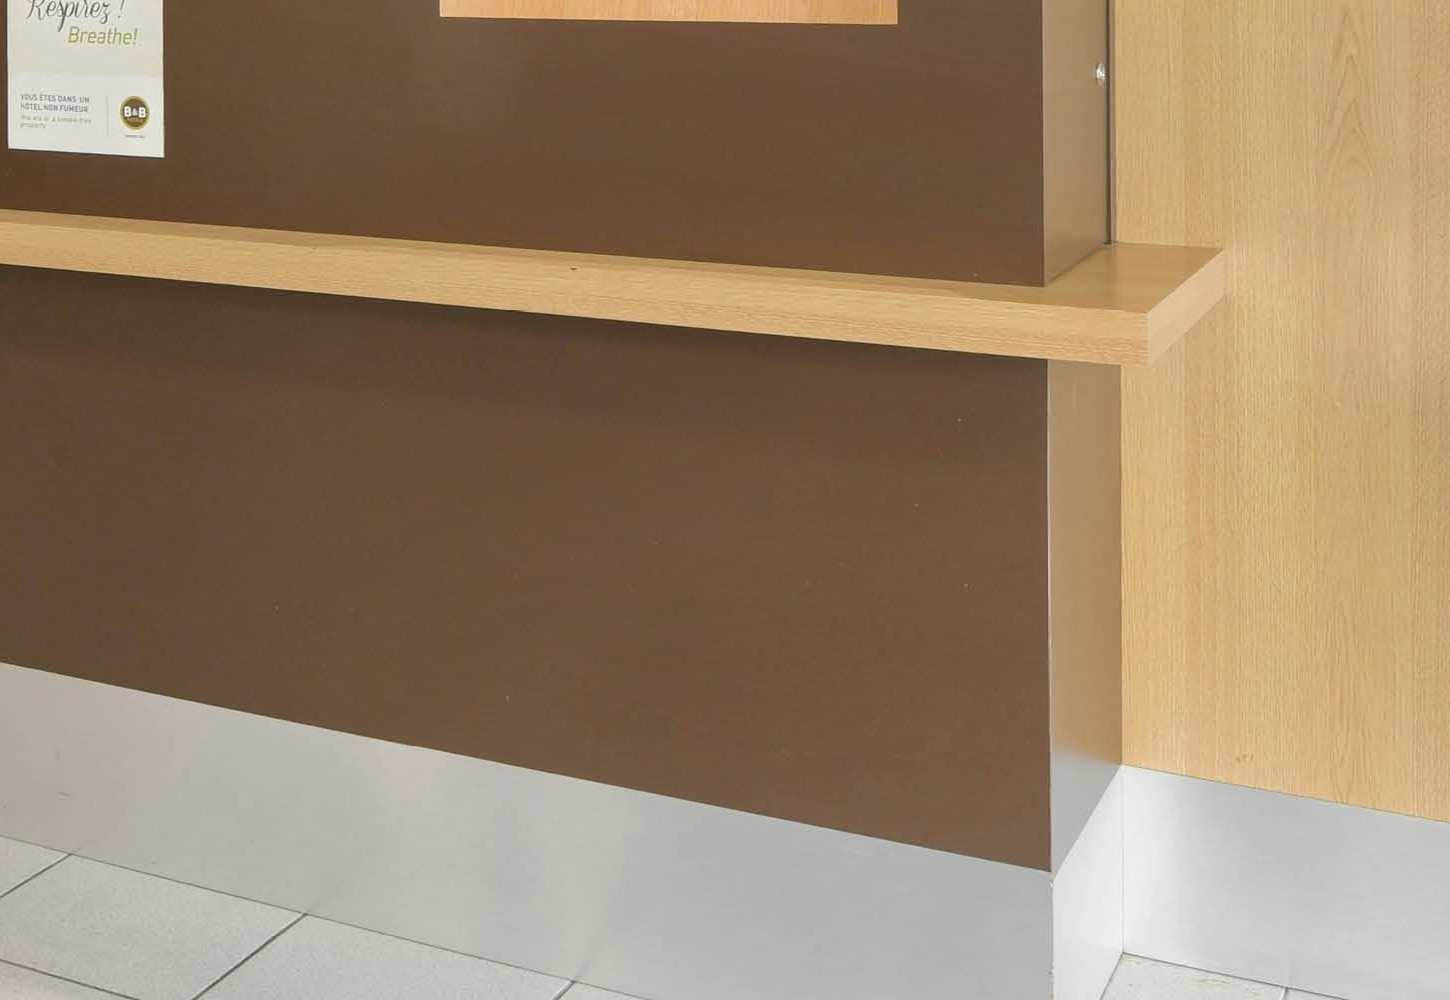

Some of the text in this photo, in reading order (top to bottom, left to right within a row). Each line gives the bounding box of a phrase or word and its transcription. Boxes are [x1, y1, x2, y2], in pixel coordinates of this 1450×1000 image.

[67, 25, 138, 46] Breathe!
[58, 95, 76, 103] DANS
[59, 104, 89, 113] FUMEUR
[124, 106, 146, 118] B&B
